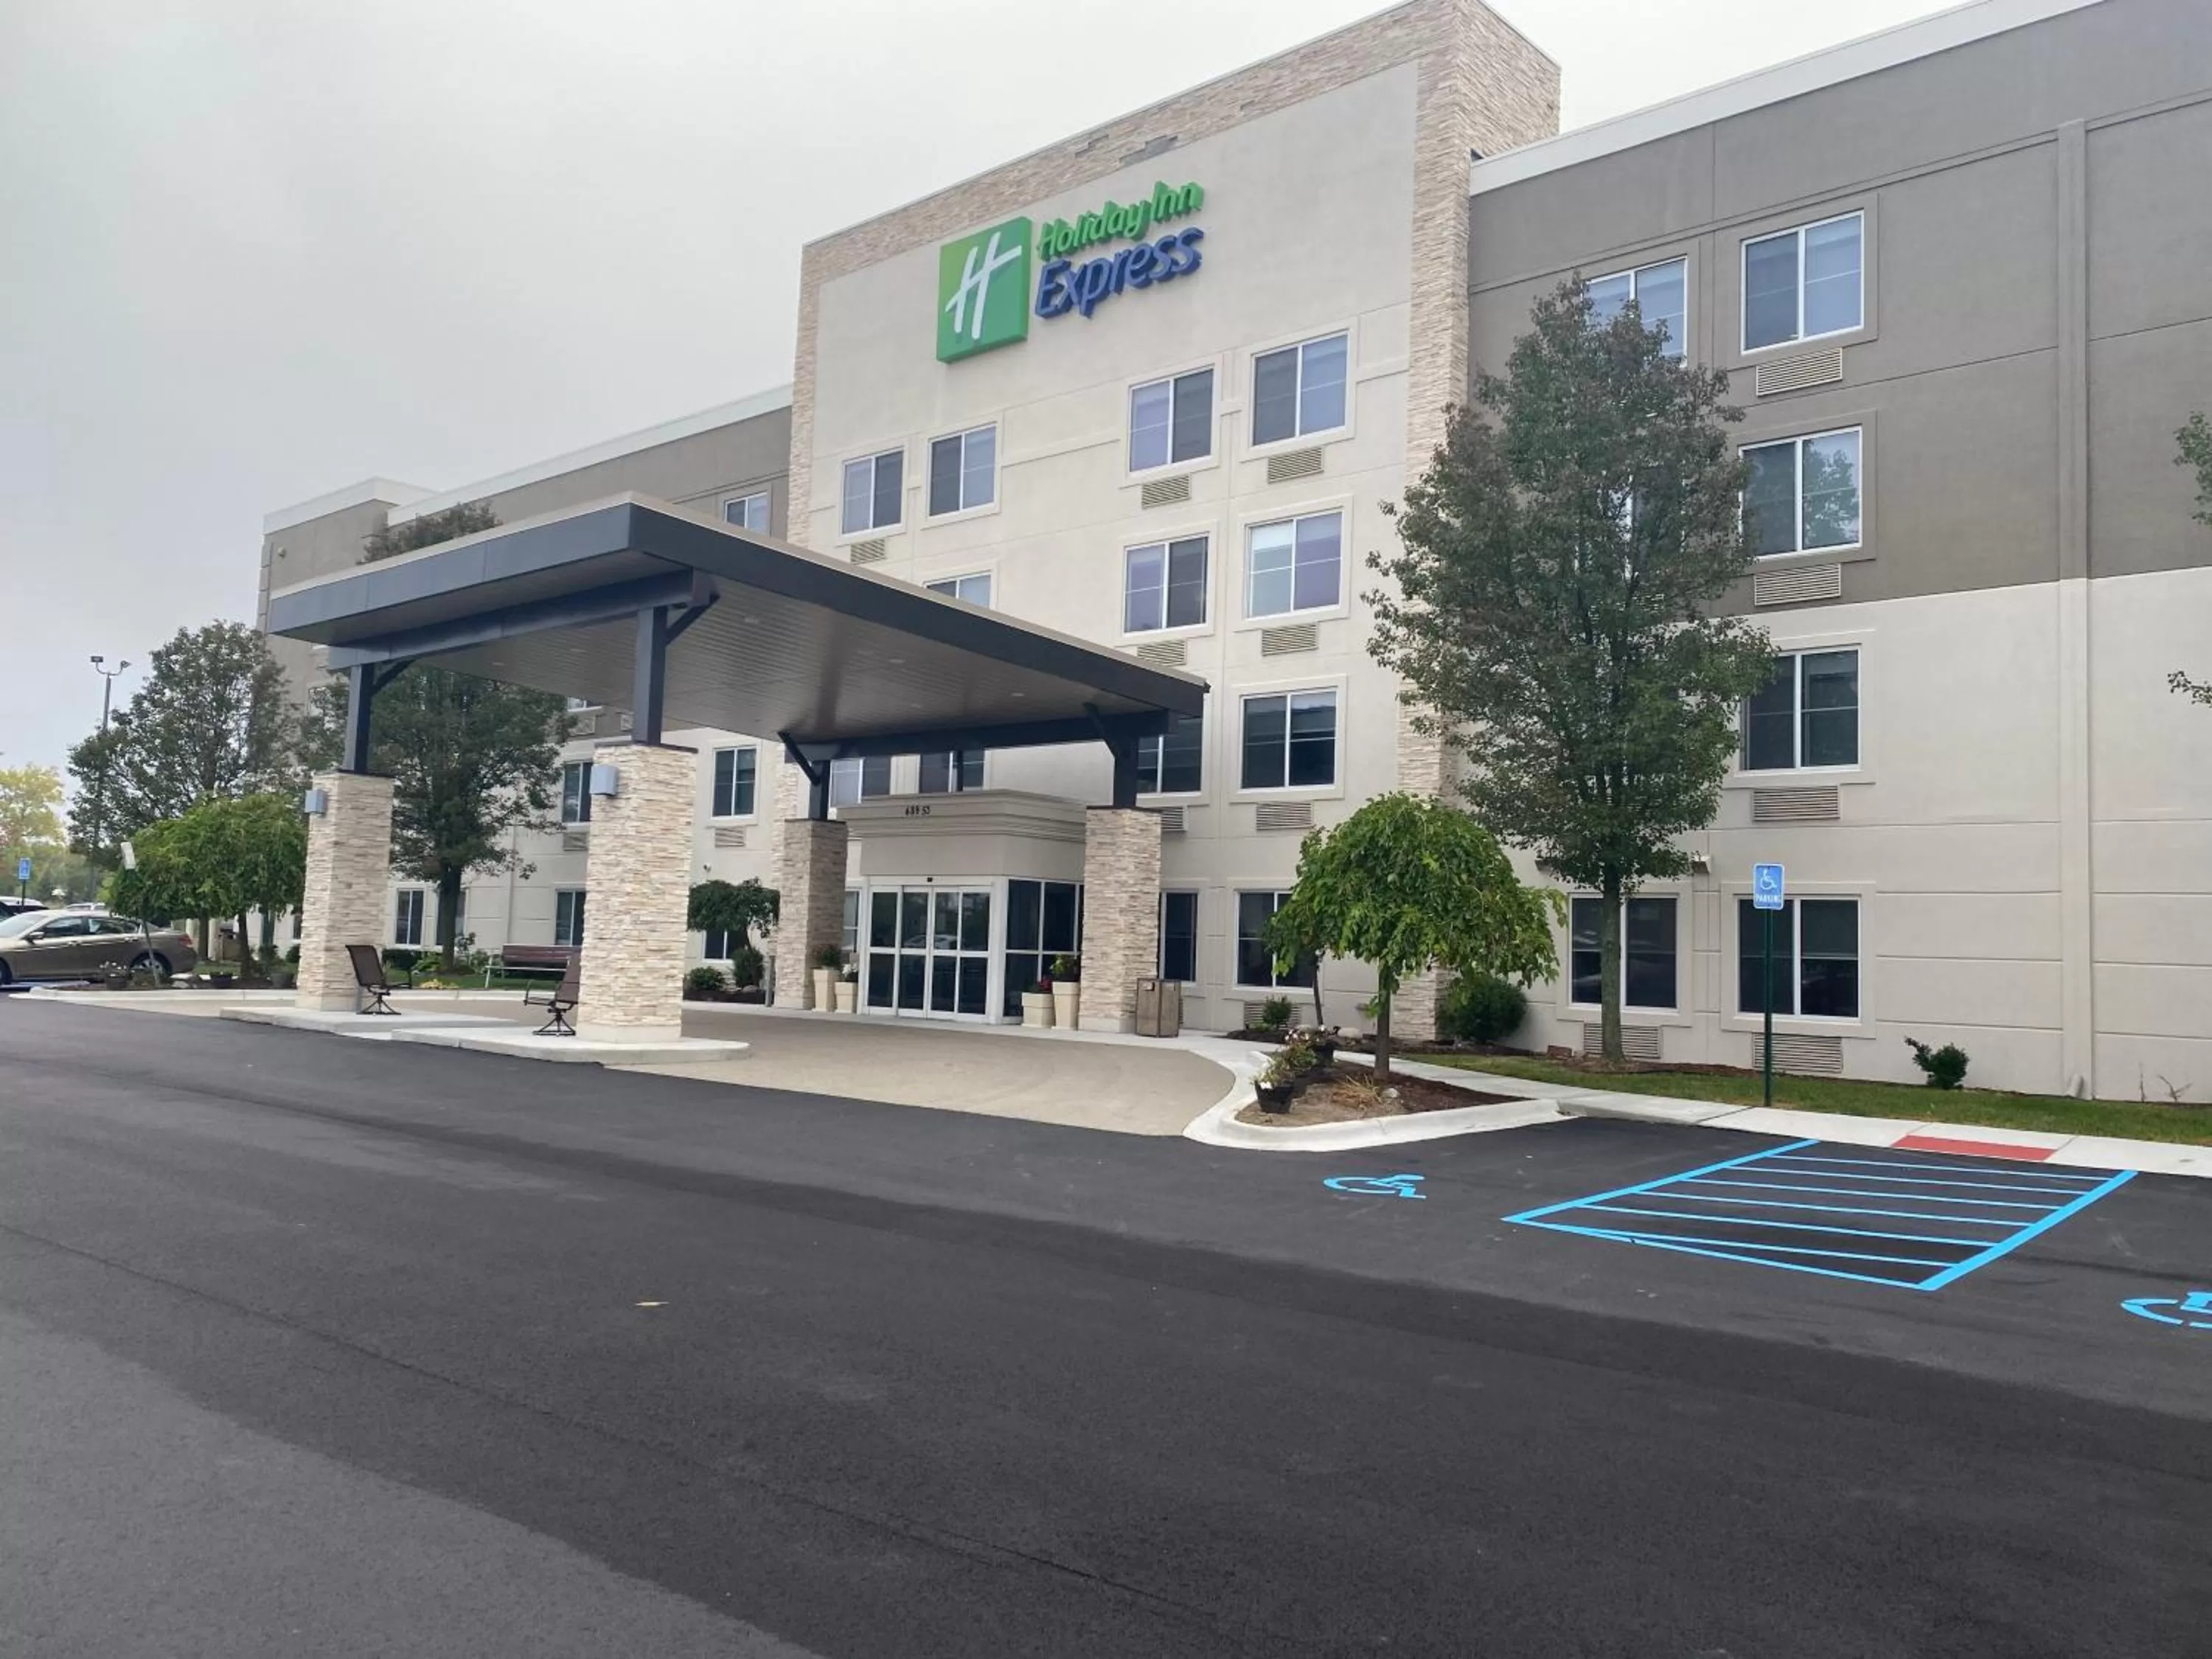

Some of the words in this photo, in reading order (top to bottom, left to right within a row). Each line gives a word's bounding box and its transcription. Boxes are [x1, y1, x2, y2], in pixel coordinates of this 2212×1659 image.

[1036, 200, 1151, 261] Holiday
[1150, 181, 1204, 222] Inn
[1035, 226, 1204, 319] Express
[1756, 893, 1781, 903] PARKING
